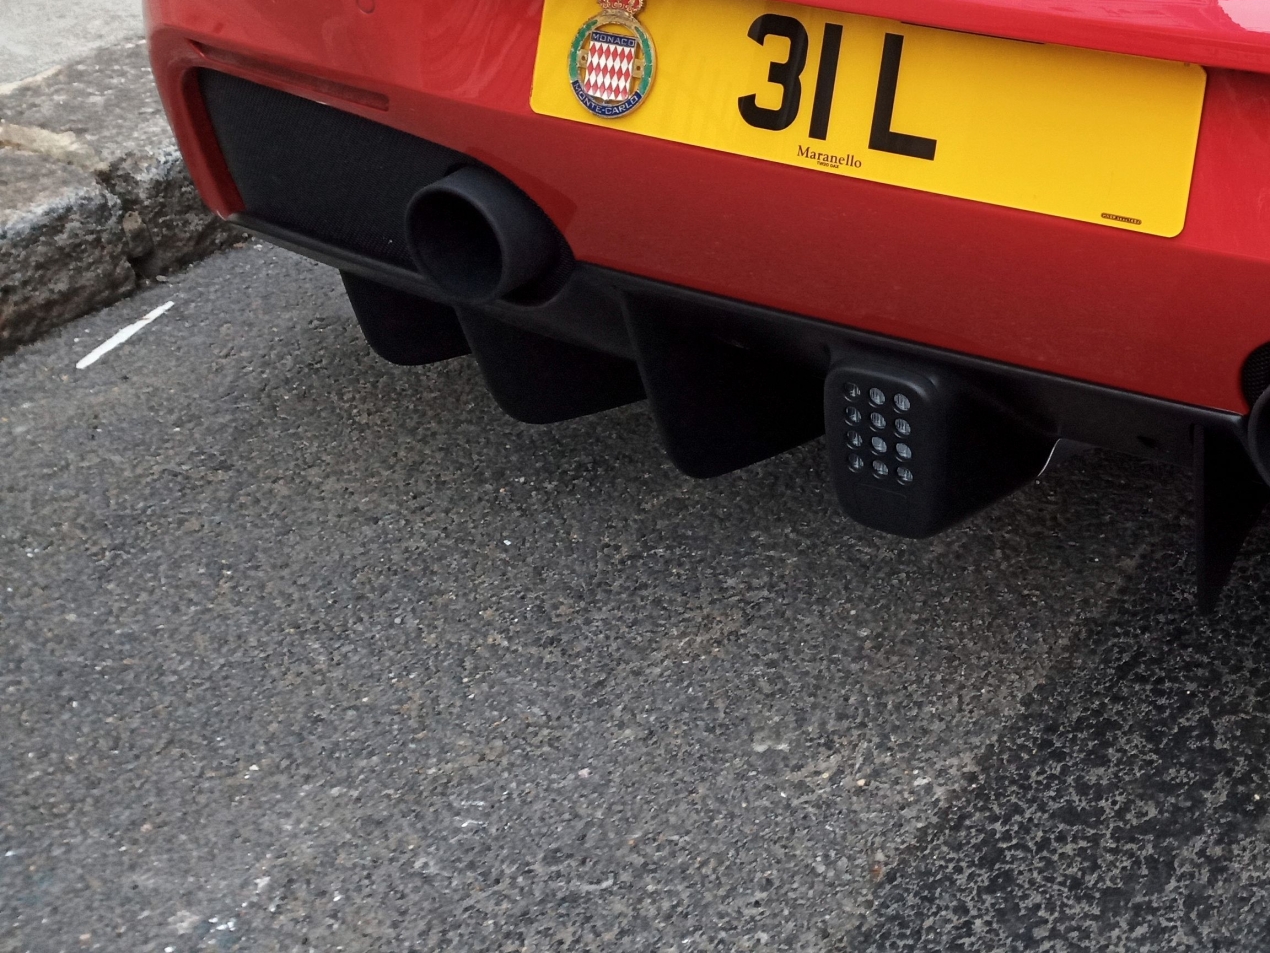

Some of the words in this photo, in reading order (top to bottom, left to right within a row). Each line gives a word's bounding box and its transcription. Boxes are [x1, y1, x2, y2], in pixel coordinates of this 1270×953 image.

[592, 33, 635, 47] MONACO
[573, 82, 639, 115] MONTE-CARLO
[868, 32, 937, 161] L
[797, 144, 862, 169] Maranello
